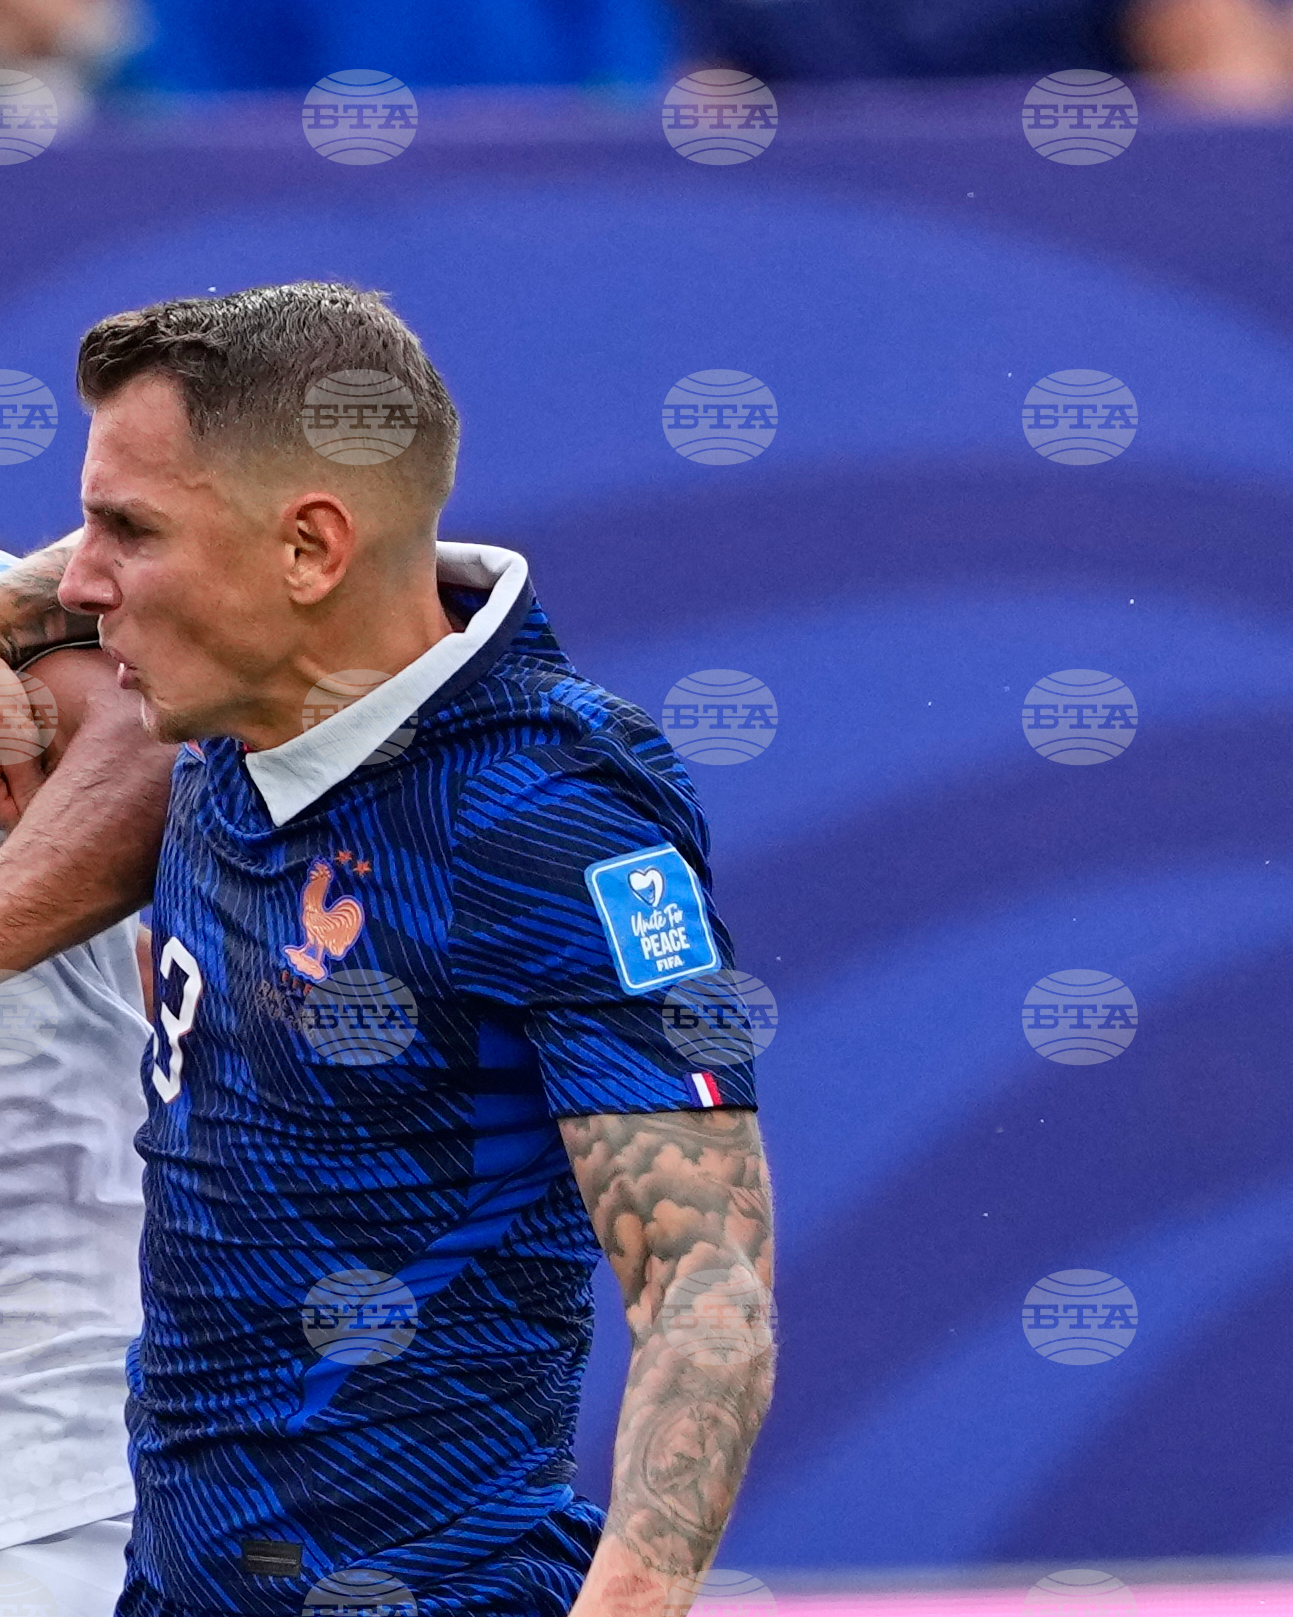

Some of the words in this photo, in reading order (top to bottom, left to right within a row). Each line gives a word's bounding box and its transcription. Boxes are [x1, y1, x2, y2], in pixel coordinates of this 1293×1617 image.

[630, 908, 666, 938] Unite
[640, 927, 691, 960] PEACE
[656, 955, 684, 972] FIFA
[152, 936, 203, 1104] 3
